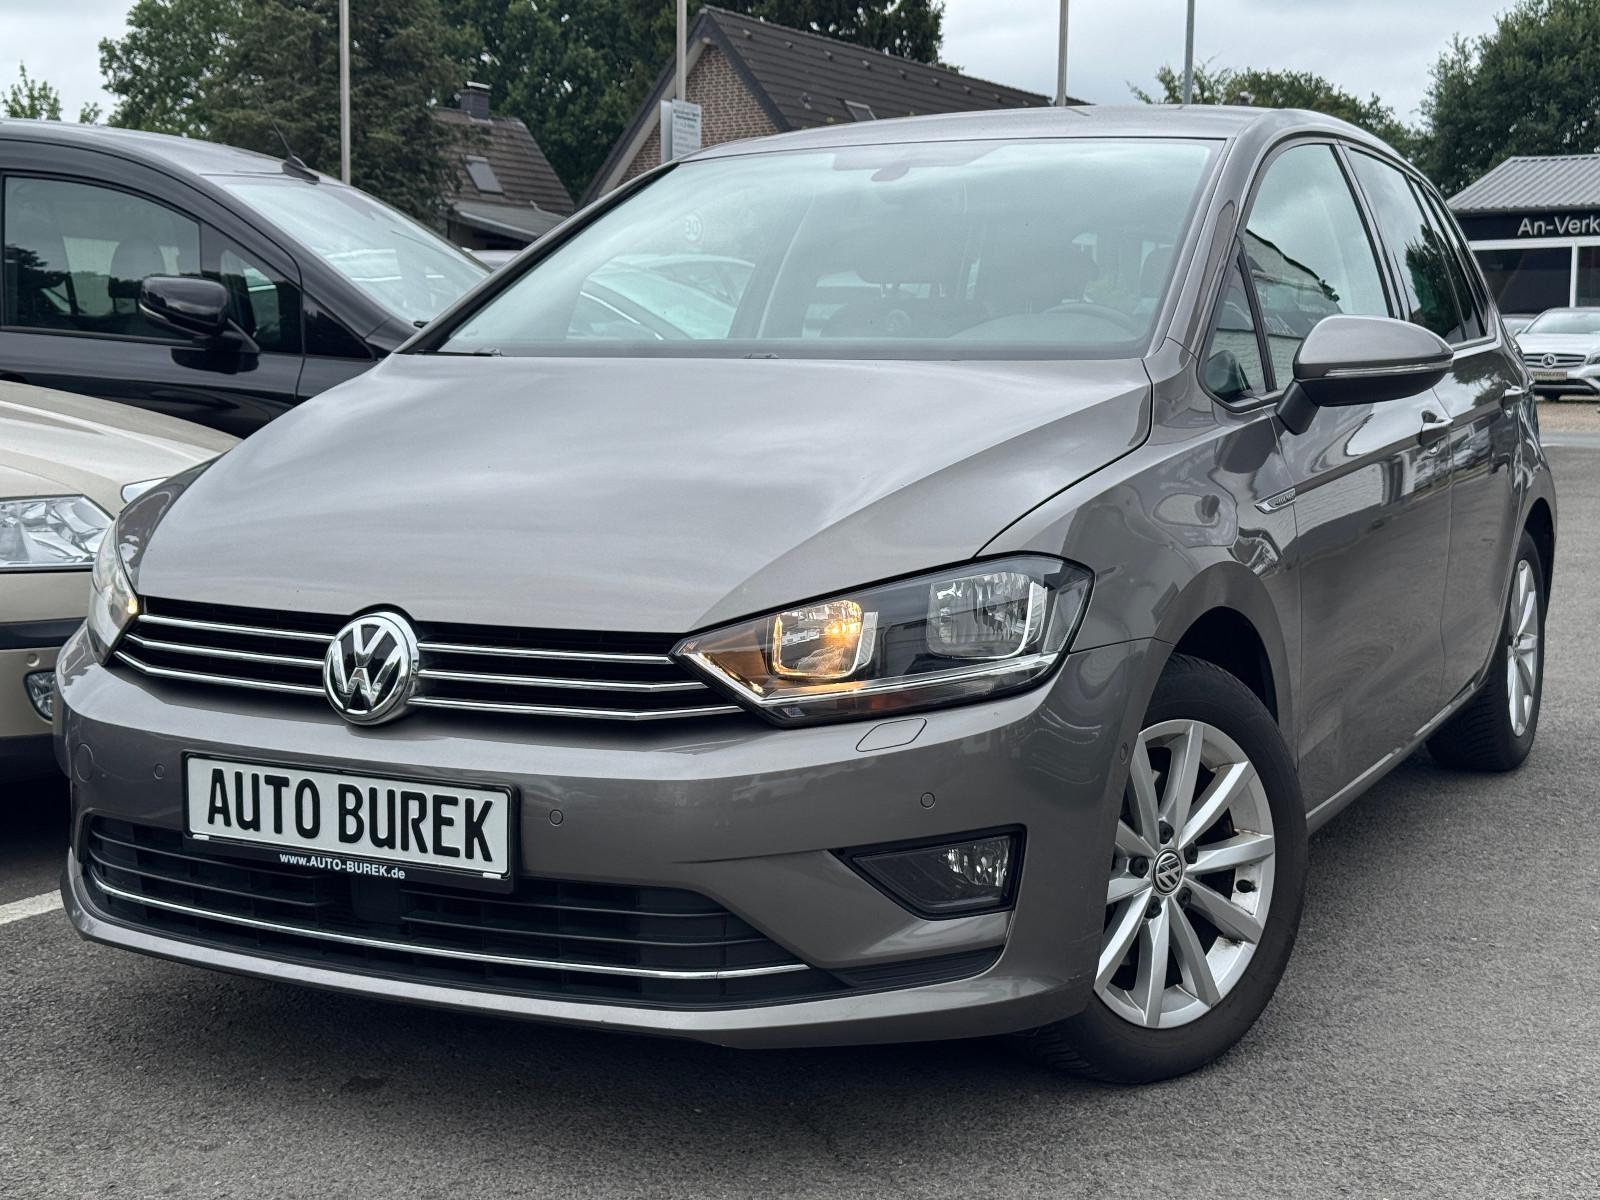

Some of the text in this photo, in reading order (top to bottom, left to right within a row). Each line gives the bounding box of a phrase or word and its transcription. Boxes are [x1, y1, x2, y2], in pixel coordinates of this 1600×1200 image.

[207, 768, 493, 862] AUTO BUREK
[279, 852, 405, 879] www.AUTO-BUREK.de
